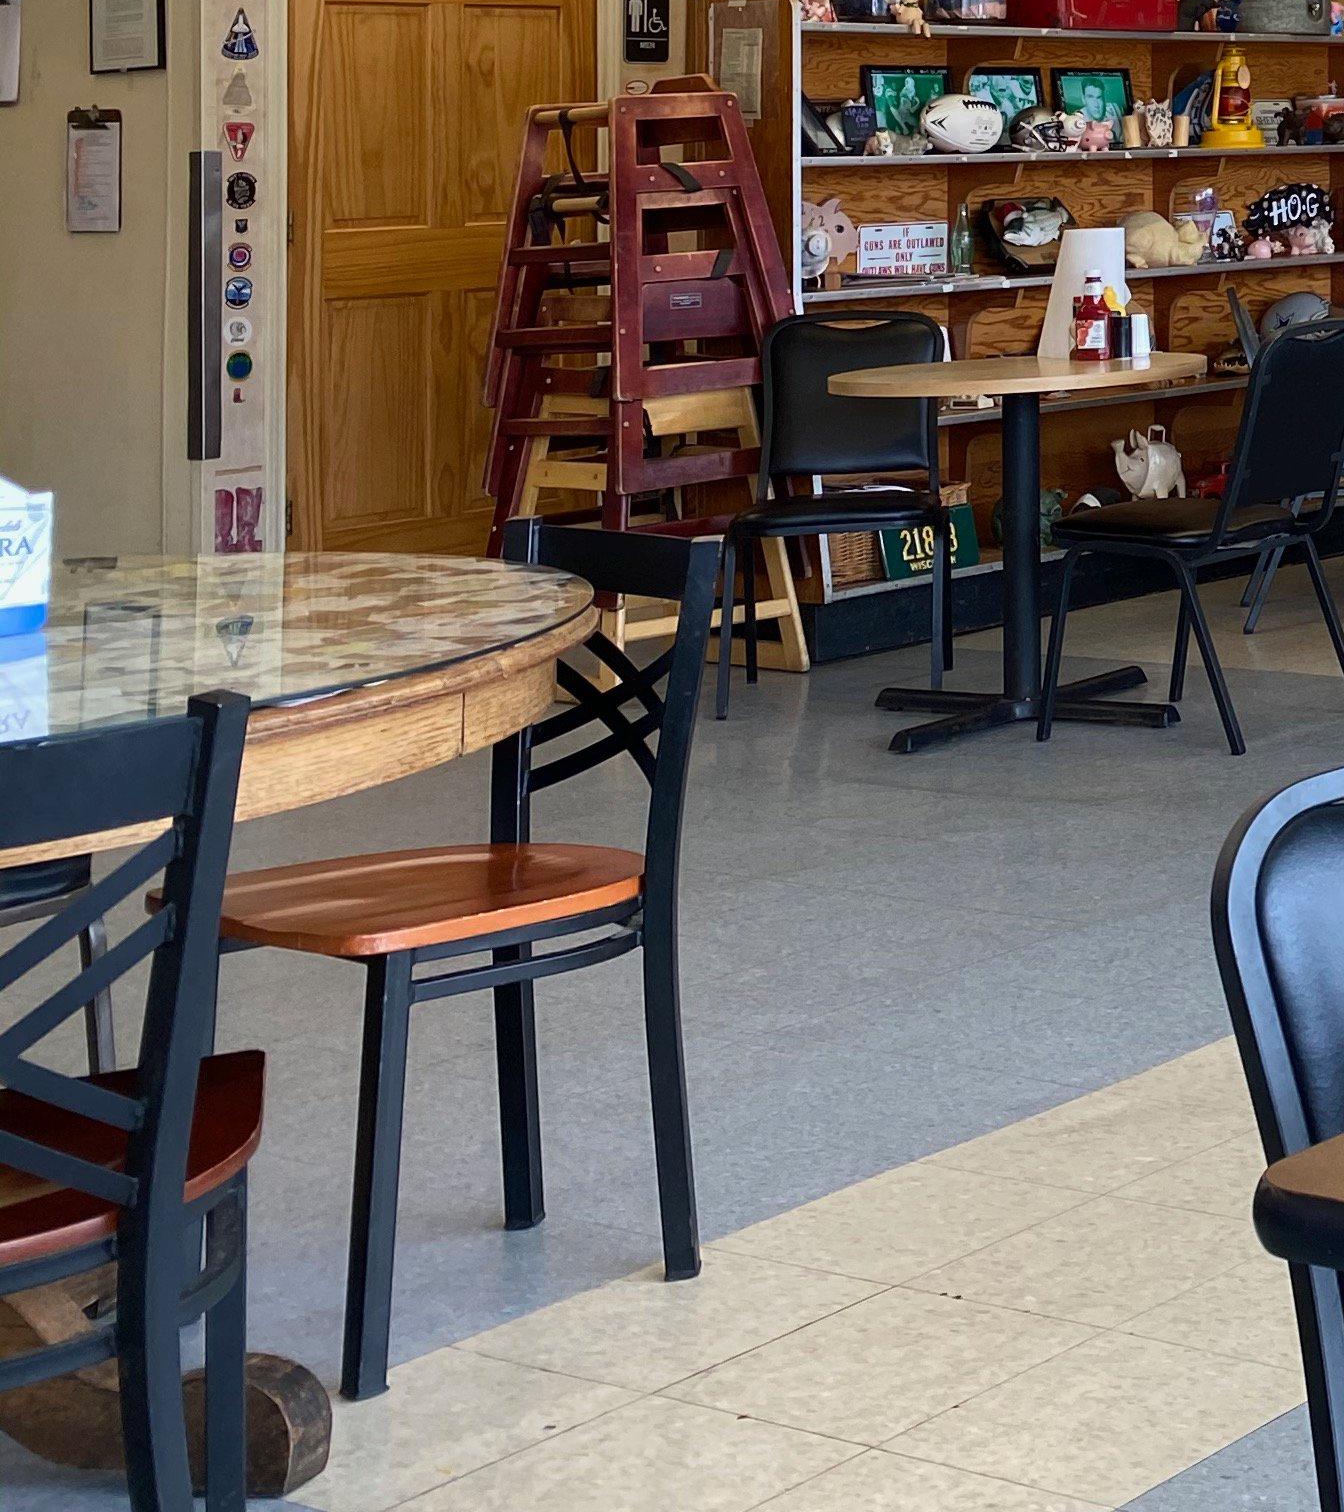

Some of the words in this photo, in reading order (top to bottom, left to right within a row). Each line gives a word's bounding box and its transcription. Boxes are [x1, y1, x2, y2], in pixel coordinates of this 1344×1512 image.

[902, 227, 910, 238] IF
[863, 241, 884, 251] GUNS
[888, 240, 902, 250] ARE
[906, 237, 945, 250] OUTLAWED
[895, 252, 914, 262] ONLY
[911, 263, 927, 274] HAVE
[929, 262, 946, 273] GUNS
[899, 522, 958, 561] 218
[910, 555, 957, 572] WISCN
